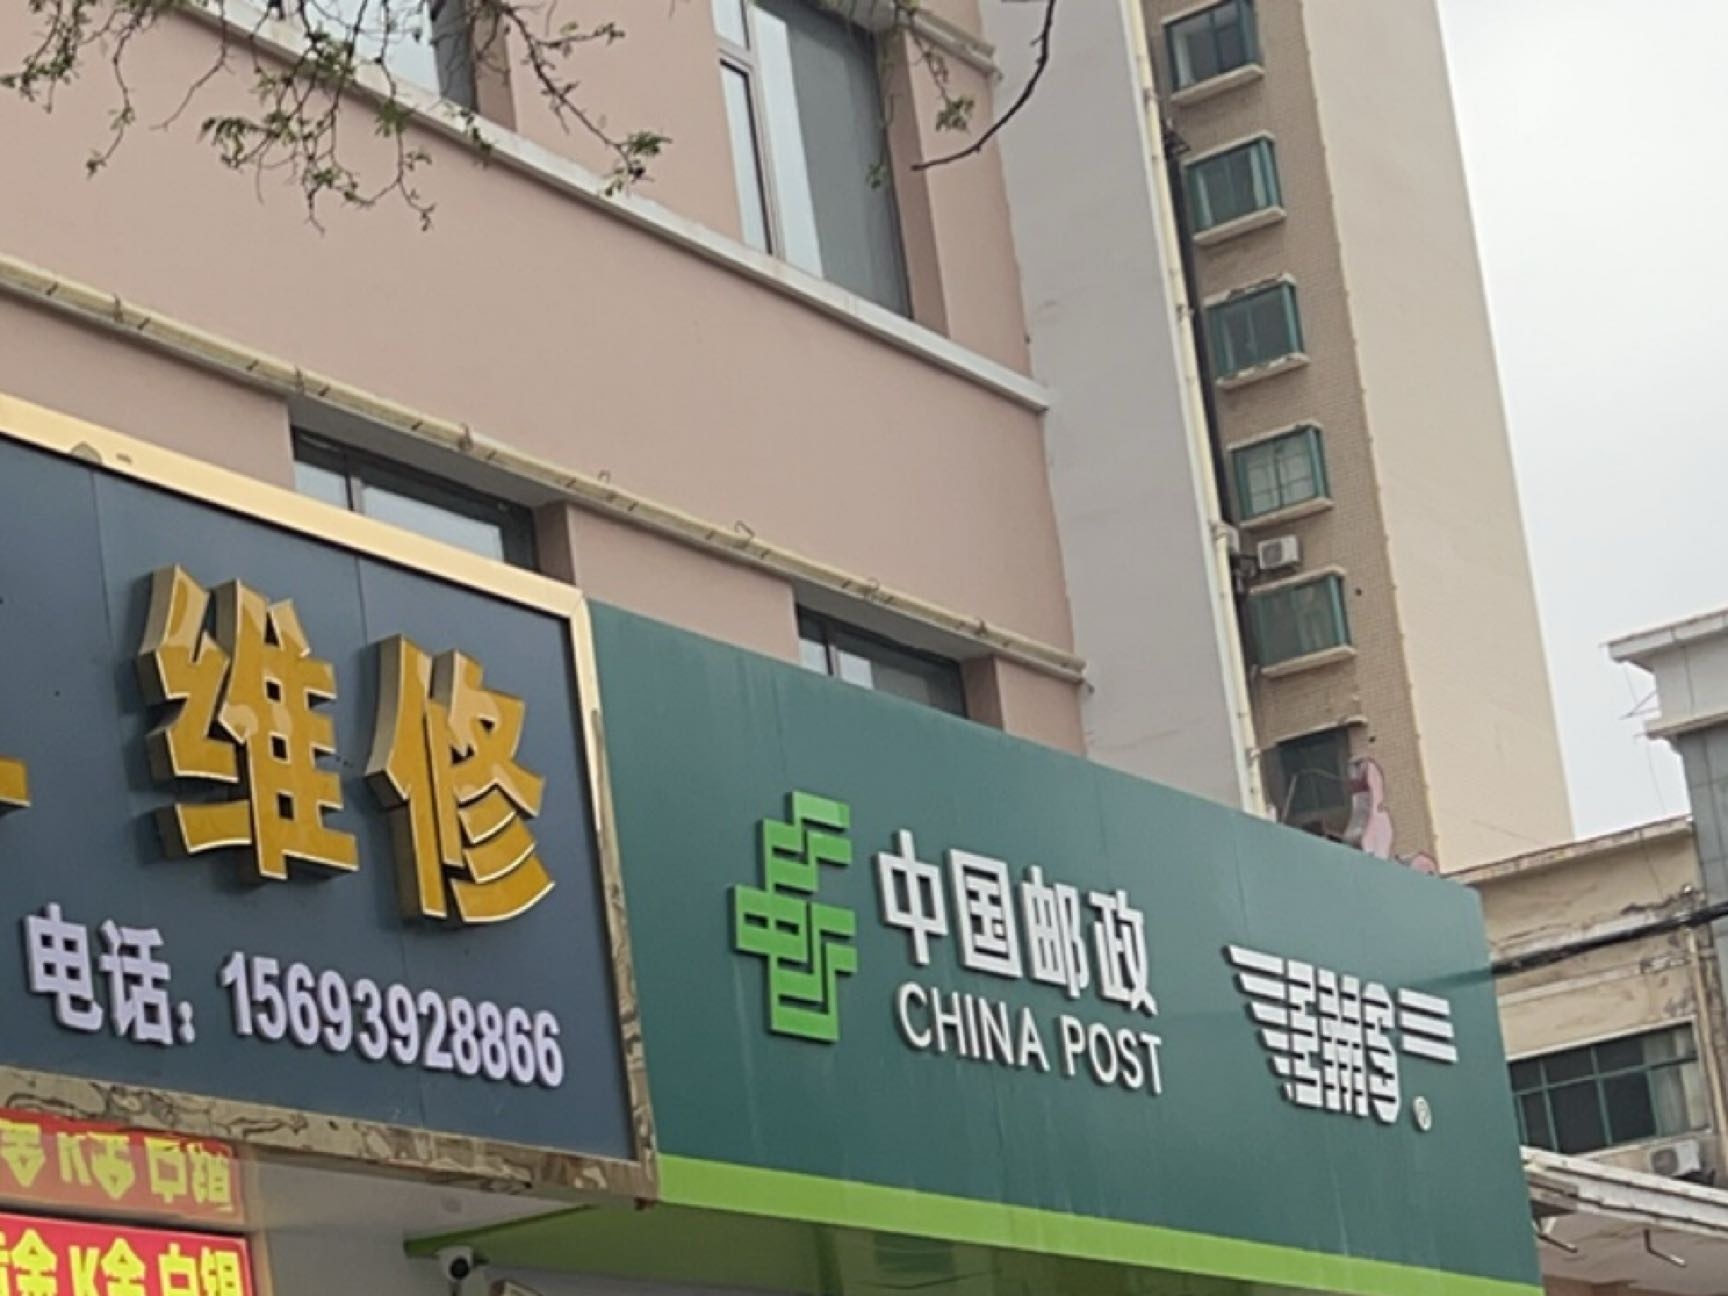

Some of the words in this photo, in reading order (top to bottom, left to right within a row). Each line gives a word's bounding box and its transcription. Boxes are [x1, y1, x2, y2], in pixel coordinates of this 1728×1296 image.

[877, 829, 1159, 1015] 中国邮政
[896, 982, 1050, 1073] CHINA
[1062, 1013, 1163, 1095] POST
